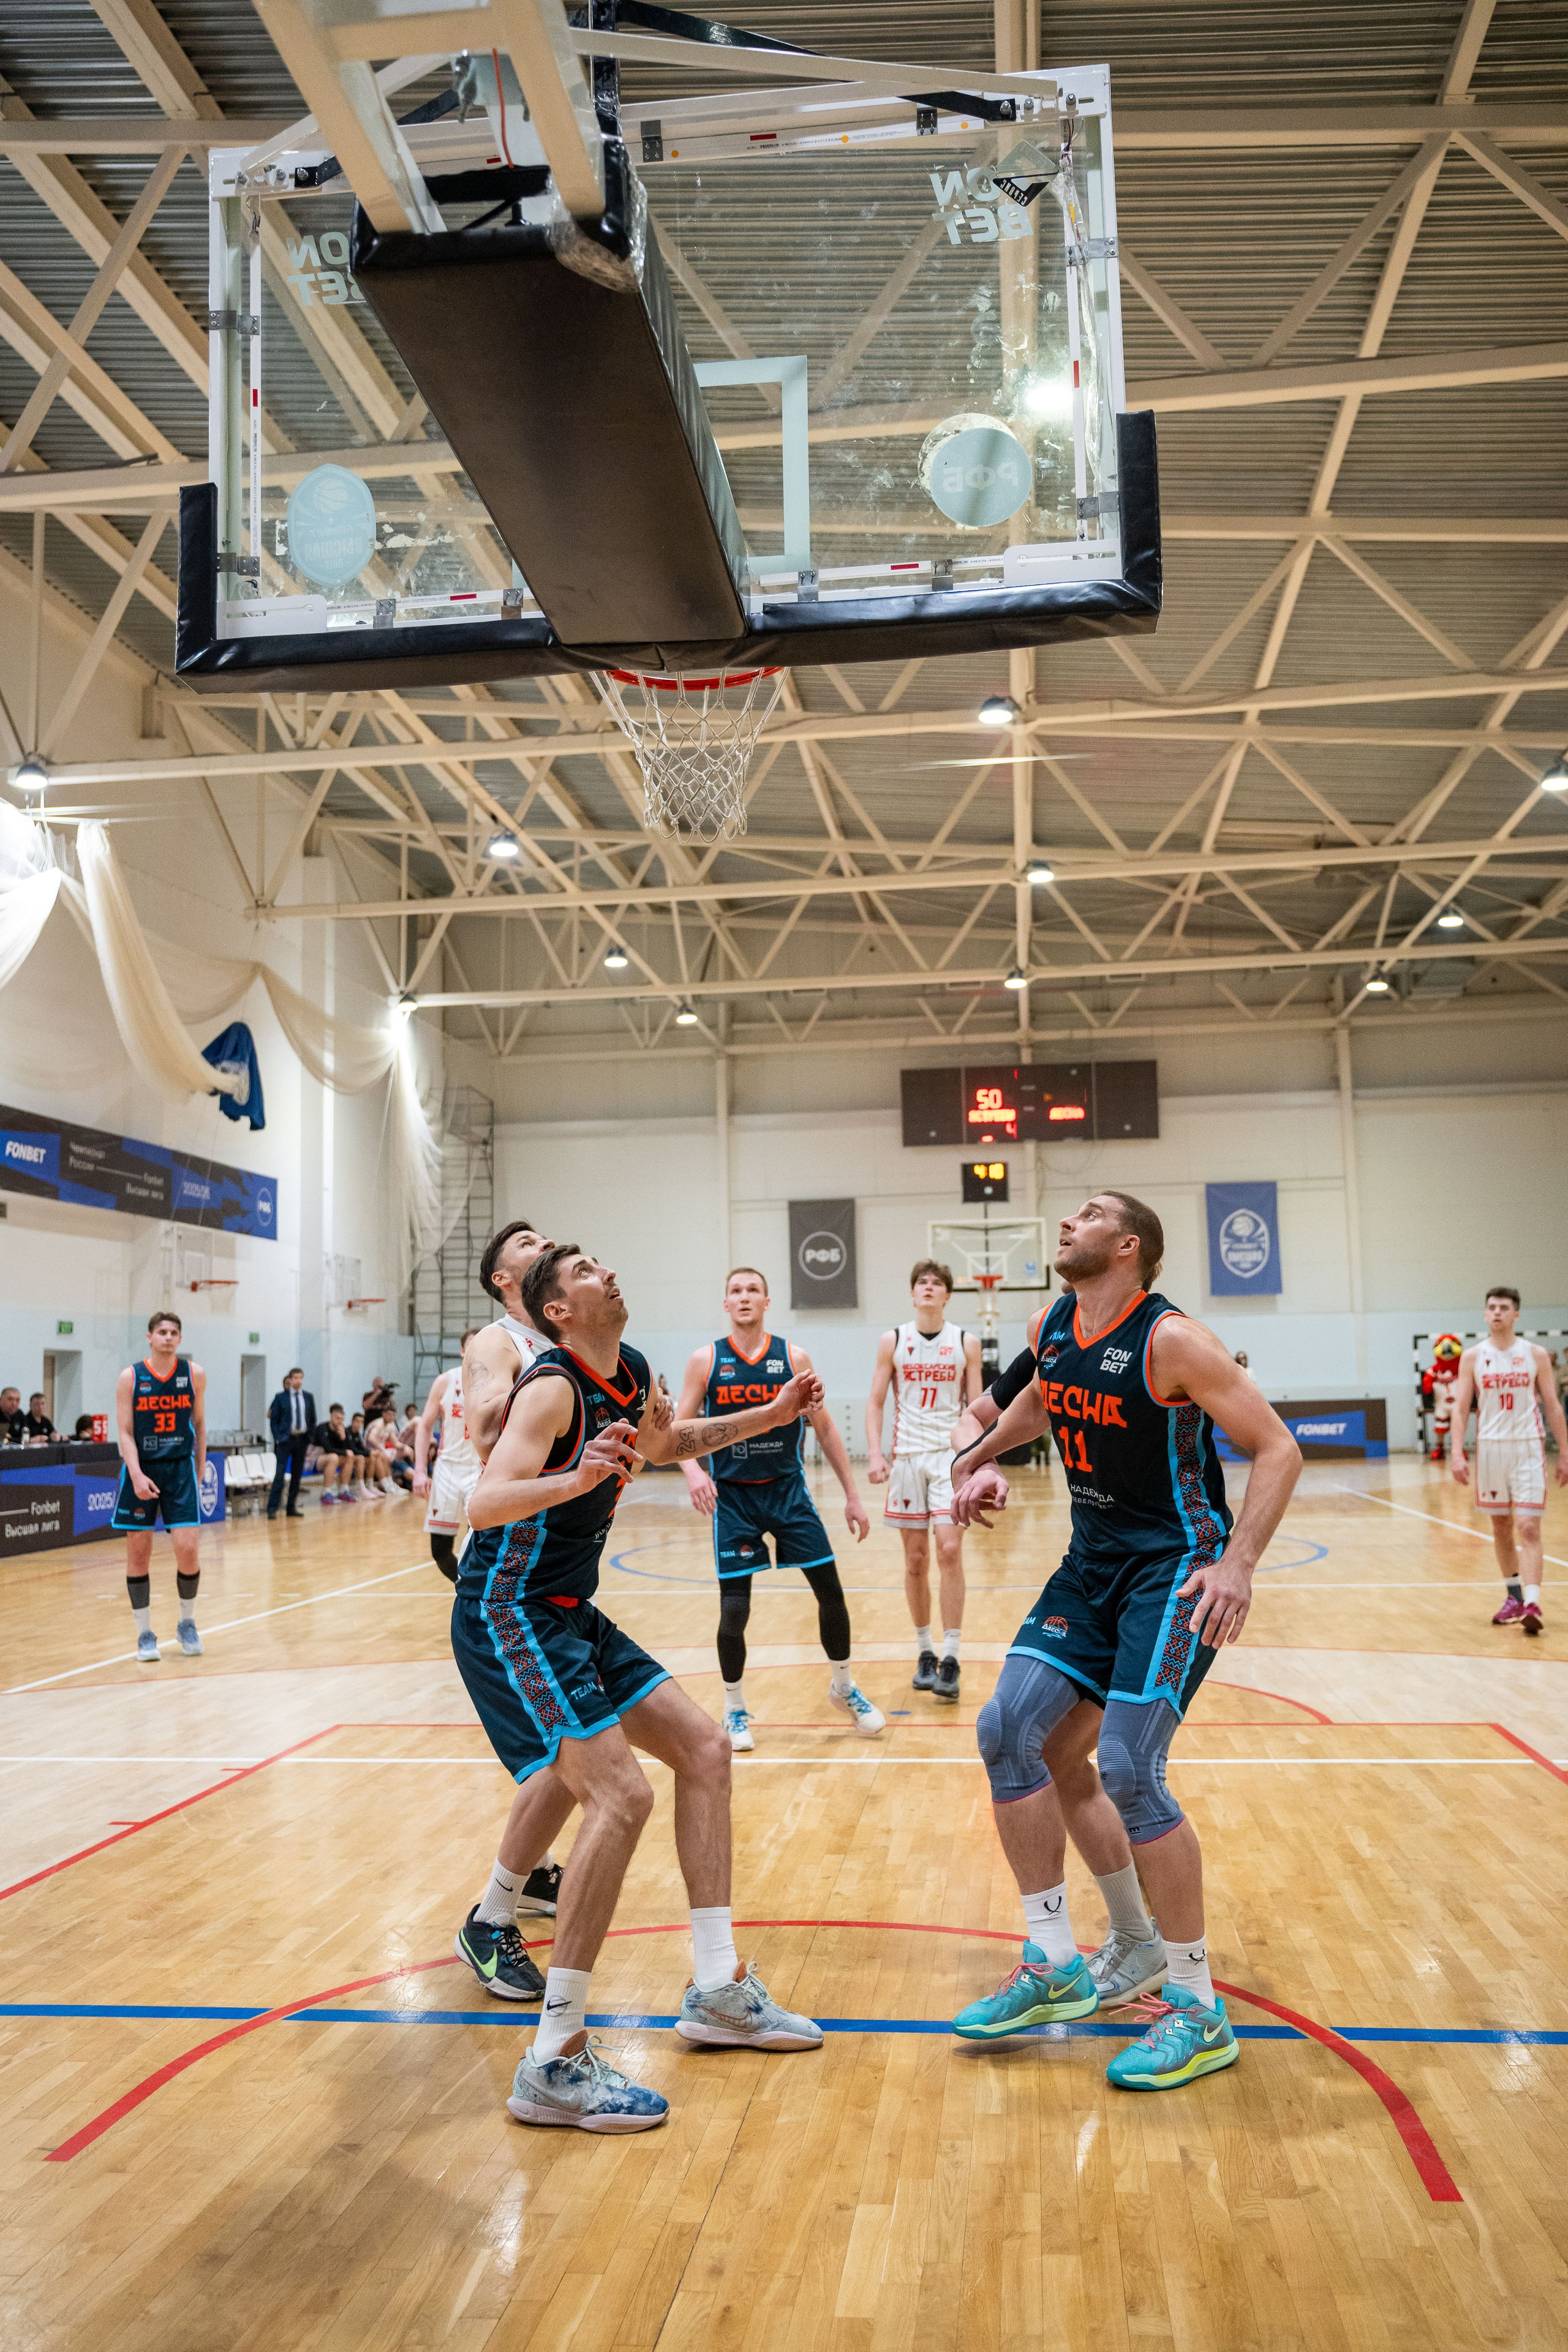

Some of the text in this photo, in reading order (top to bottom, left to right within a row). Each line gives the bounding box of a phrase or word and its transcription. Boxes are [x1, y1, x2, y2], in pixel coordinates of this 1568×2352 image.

[976, 1088, 1003, 1110] 50
[5, 1140, 47, 1164] FONBET
[805, 1248, 841, 1263] РФБ
[1103, 1347, 1133, 1363] FON
[1100, 1359, 1128, 1374] BET
[136, 1395, 192, 1411] ДЕСНА
[717, 1384, 785, 1404] ДЕСН
[921, 1387, 938, 1408] 77
[1499, 1392, 1513, 1411] 10
[154, 1412, 176, 1433] 33
[1295, 1422, 1346, 1436] FONBET
[676, 1425, 696, 1456] 24
[1058, 1426, 1093, 1472] 11
[31, 1500, 60, 1516] Fonbet
[88, 1490, 116, 1511] 2025/
[5, 1519, 60, 1538] Высшая лига
[571, 1681, 597, 1700] TEAM
